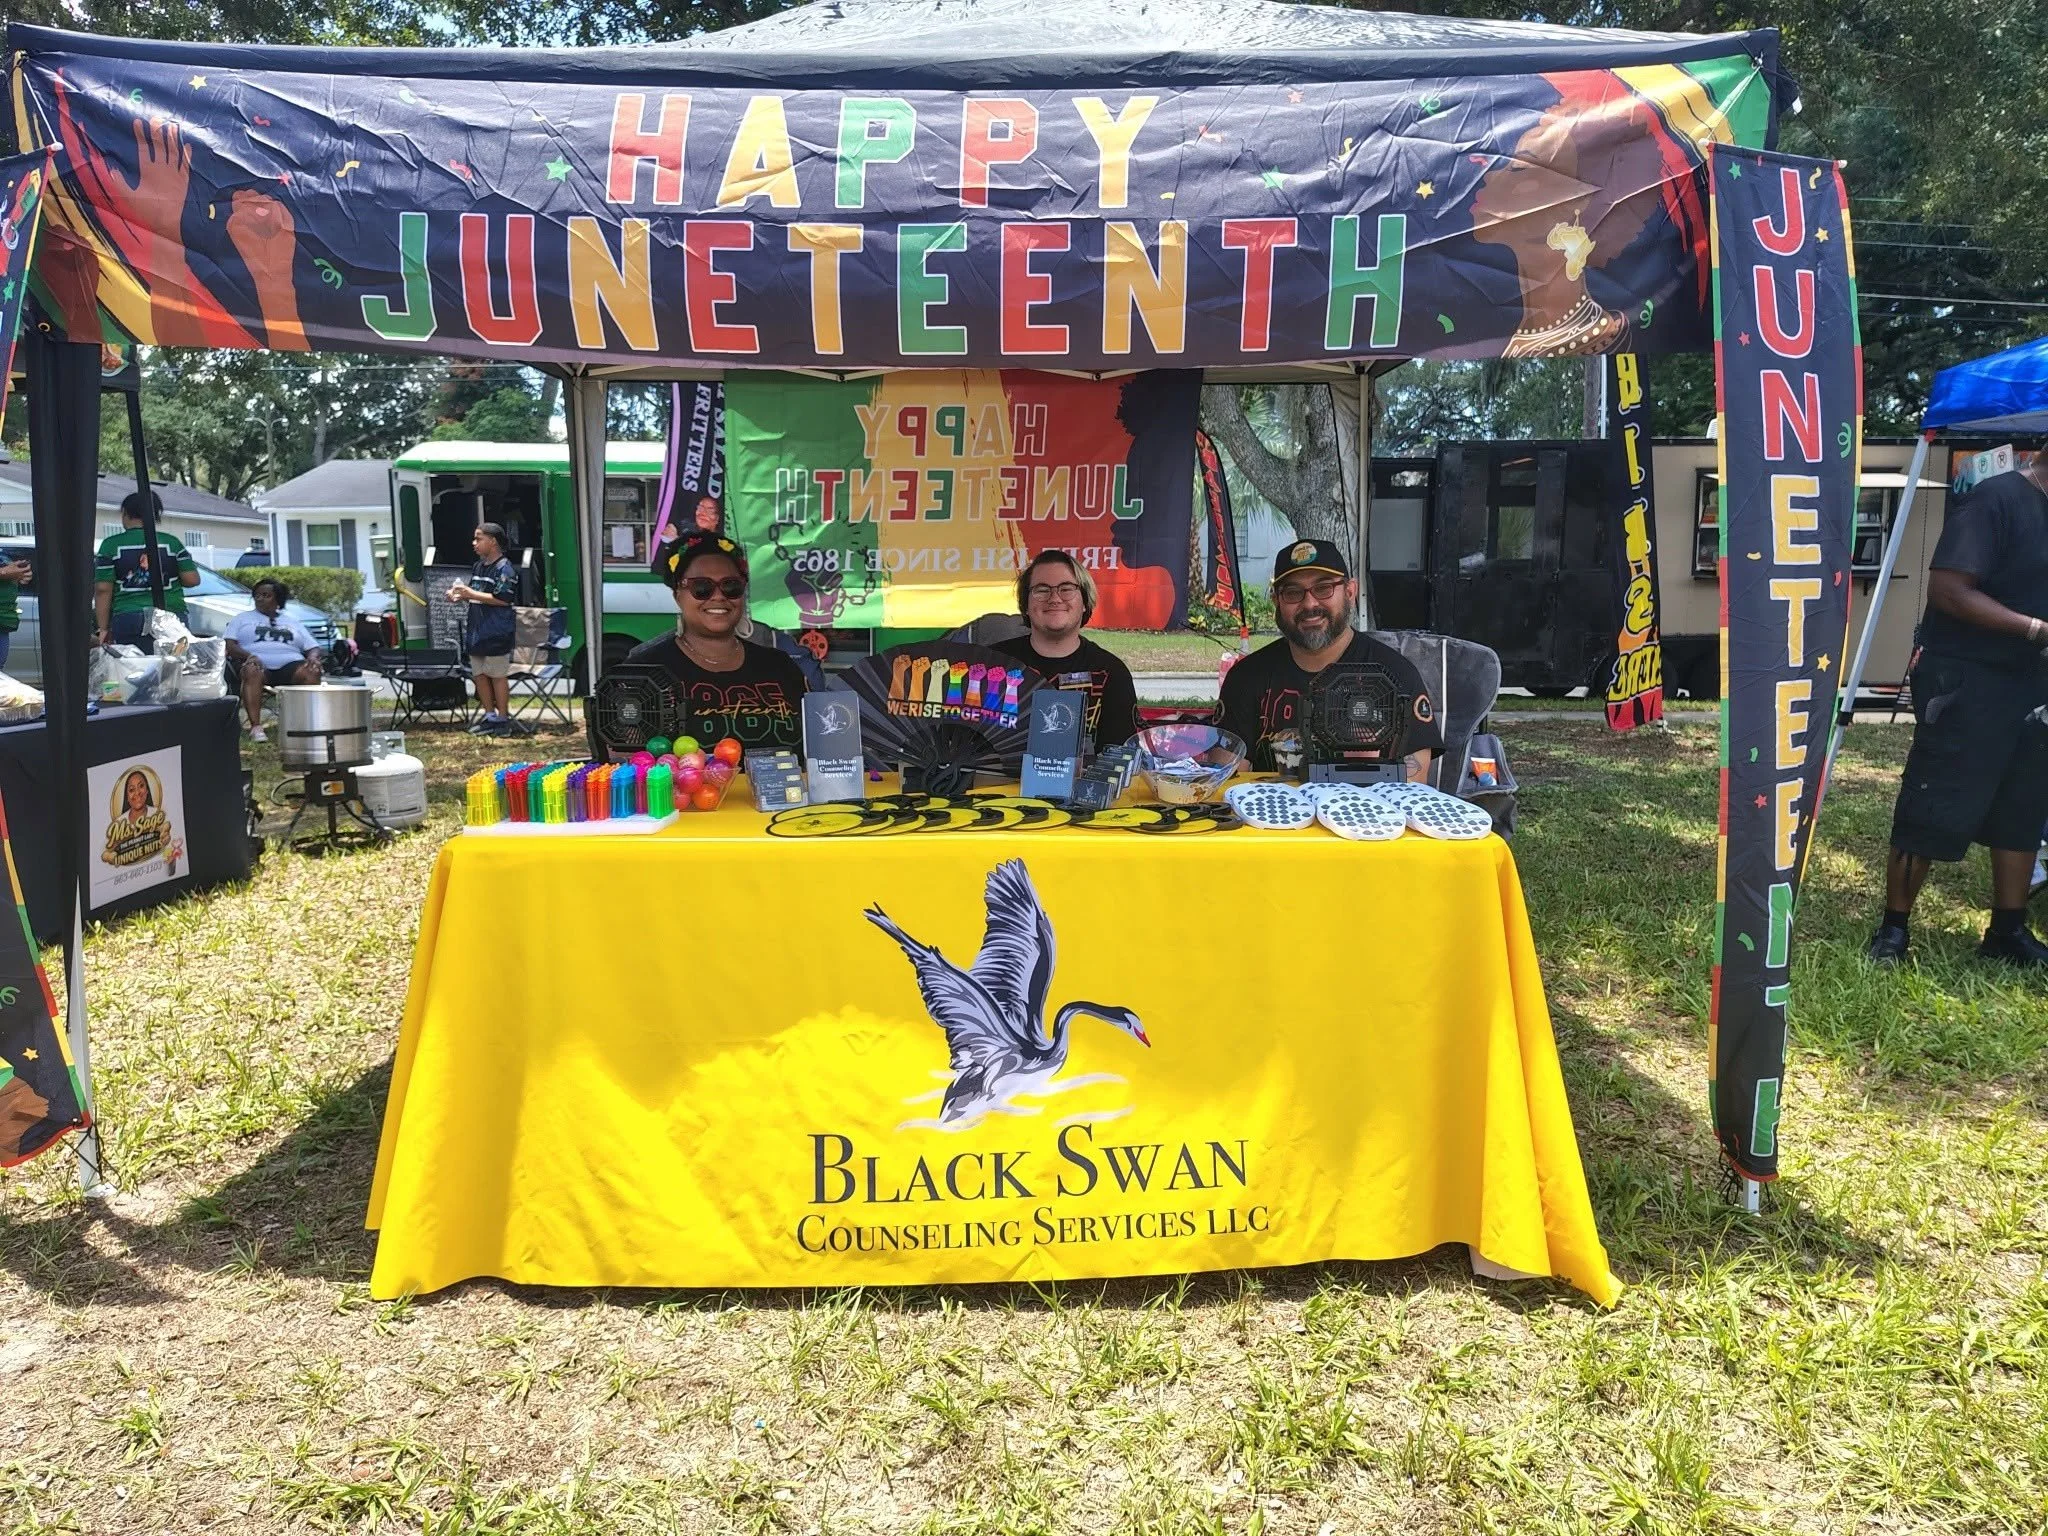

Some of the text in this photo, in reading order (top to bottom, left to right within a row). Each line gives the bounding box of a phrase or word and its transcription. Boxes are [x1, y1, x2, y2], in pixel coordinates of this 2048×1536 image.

[606, 93, 1159, 209] HAPPY
[360, 212, 1406, 355] JUNETEENTH
[682, 383, 712, 493] FRITTERS
[1750, 166, 1824, 1157] JUNETEE
[107, 812, 165, 848] Ms. Sage
[114, 847, 145, 866] UNIQUE
[1207, 1206, 1269, 1235] LLC
